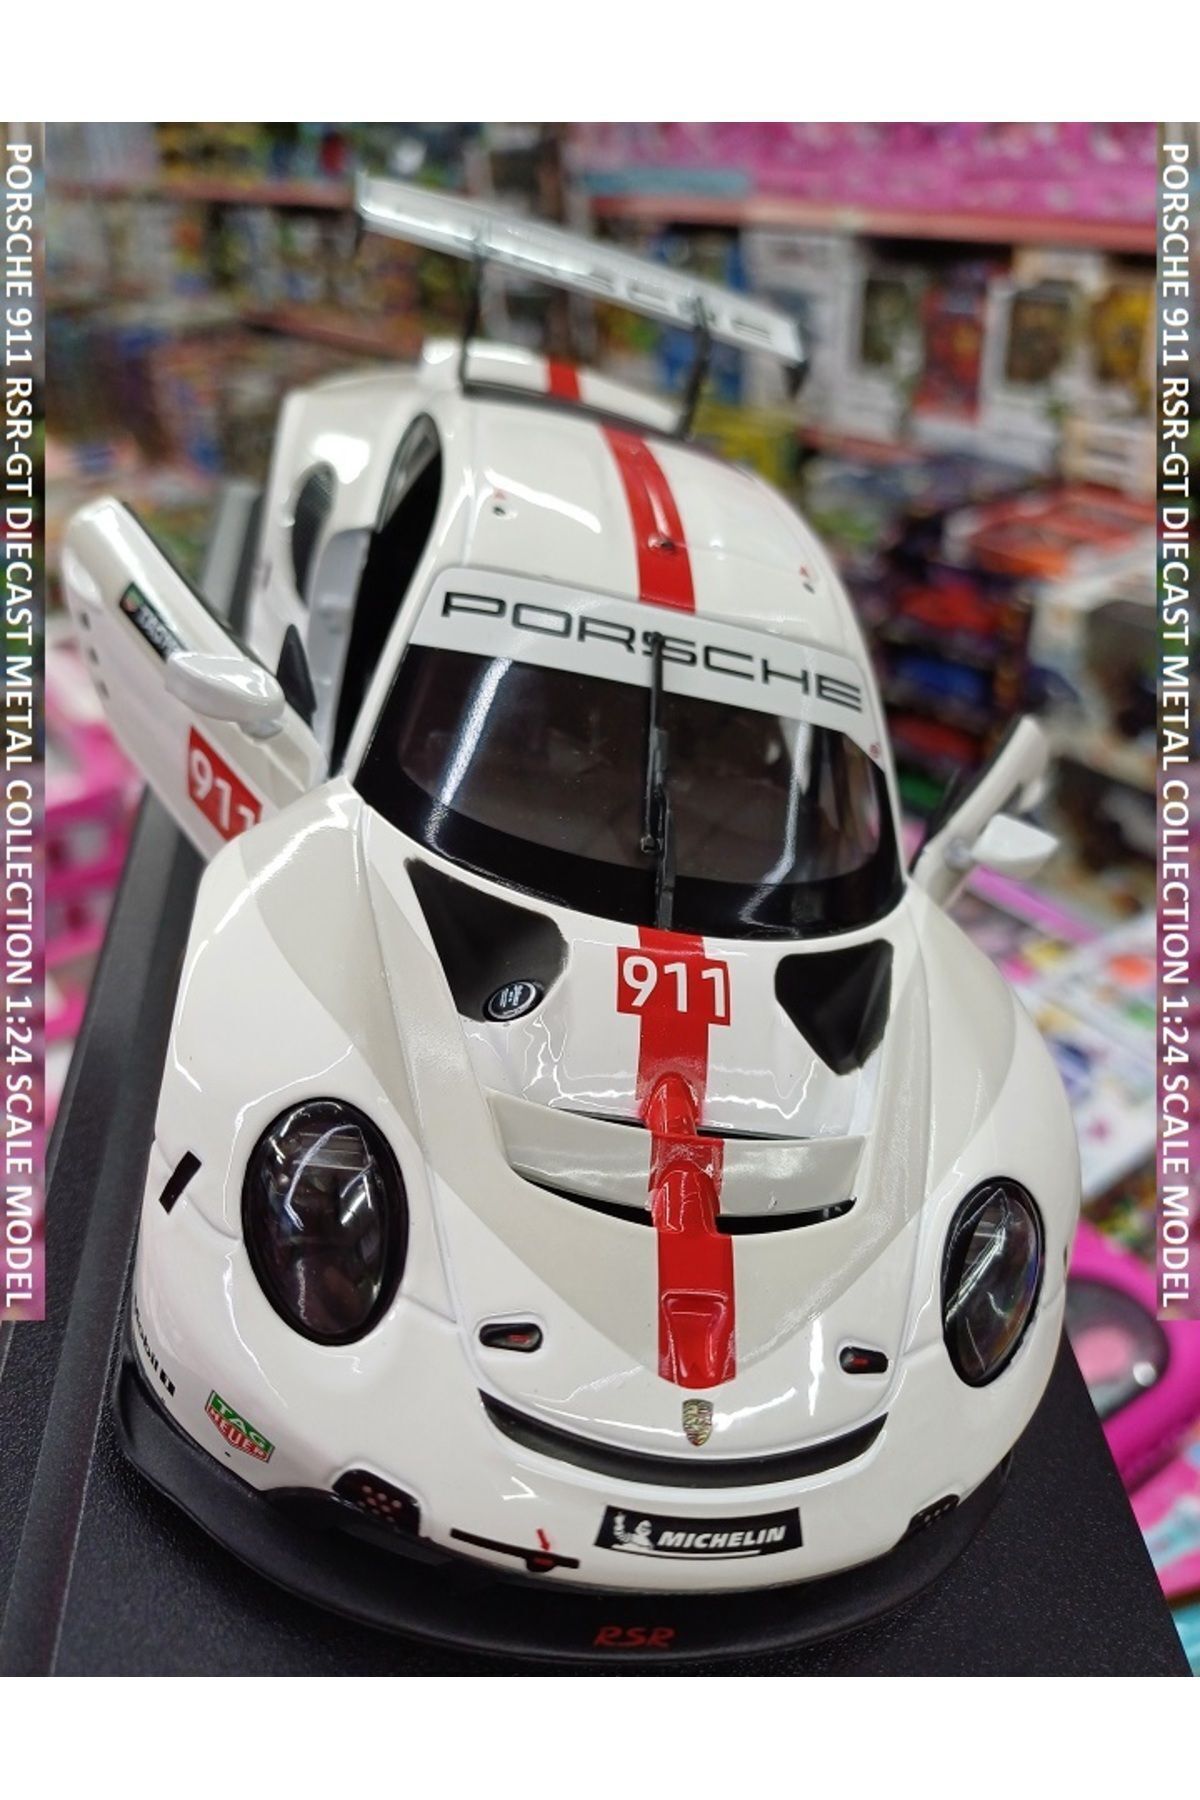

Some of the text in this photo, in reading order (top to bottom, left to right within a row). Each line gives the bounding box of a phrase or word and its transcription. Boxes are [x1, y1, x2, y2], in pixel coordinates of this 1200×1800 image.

[442, 590, 862, 712] PORSCHE
[622, 955, 726, 1018] 911
[216, 1399, 267, 1449] TAG
[656, 1525, 787, 1549] MICHELIN
[593, 1625, 676, 1649] RSR
